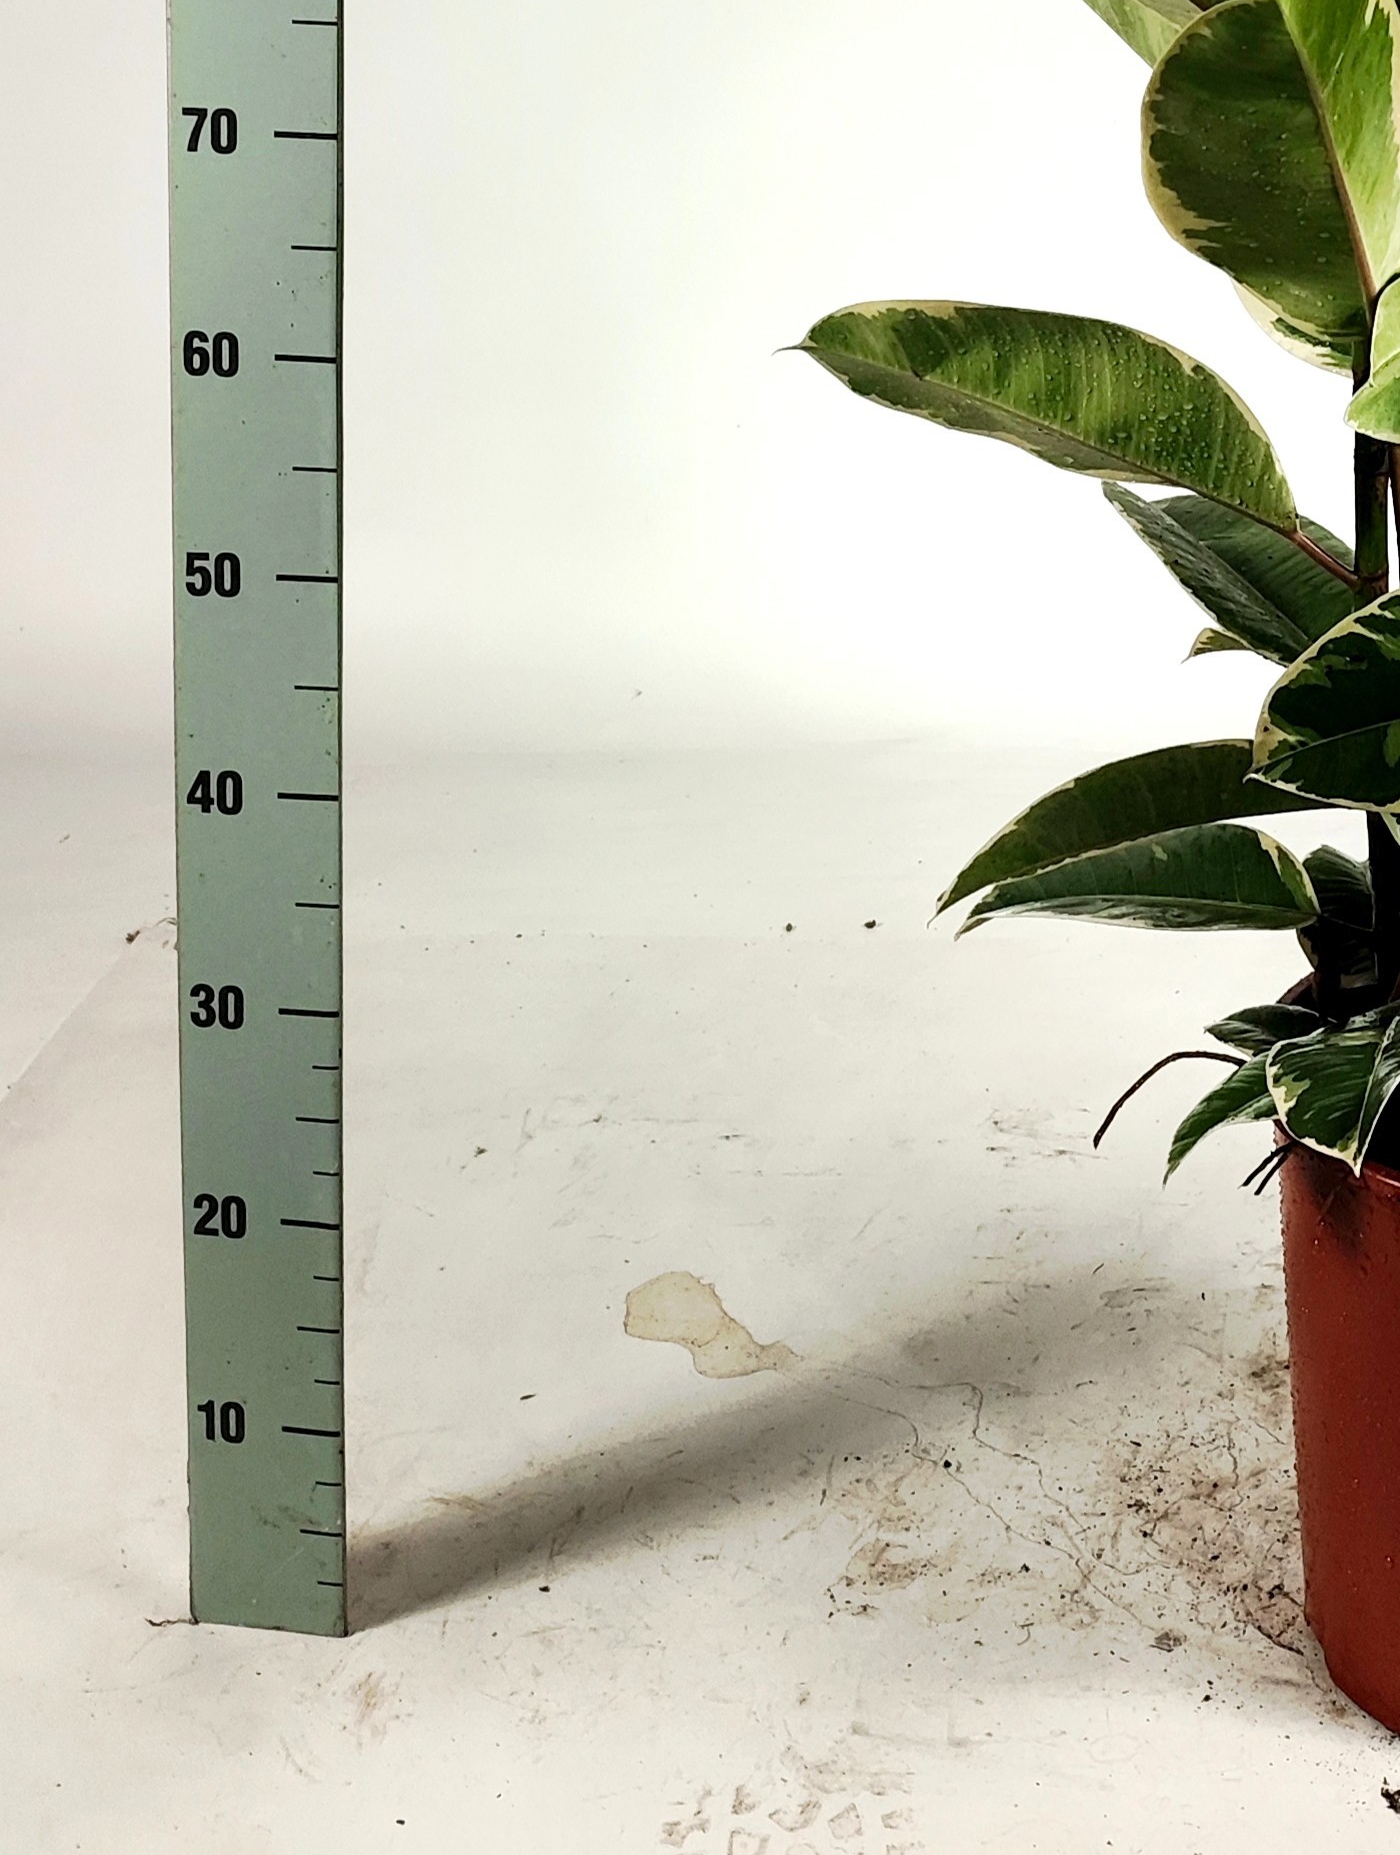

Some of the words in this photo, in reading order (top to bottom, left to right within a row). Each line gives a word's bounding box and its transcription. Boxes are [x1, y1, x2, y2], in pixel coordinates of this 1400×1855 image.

[181, 107, 238, 155] 70
[182, 330, 240, 378] 60
[185, 551, 241, 598] 50
[186, 769, 244, 816] 40
[189, 983, 245, 1031] 30
[192, 1192, 247, 1240] 20
[196, 1399, 246, 1445] 10
